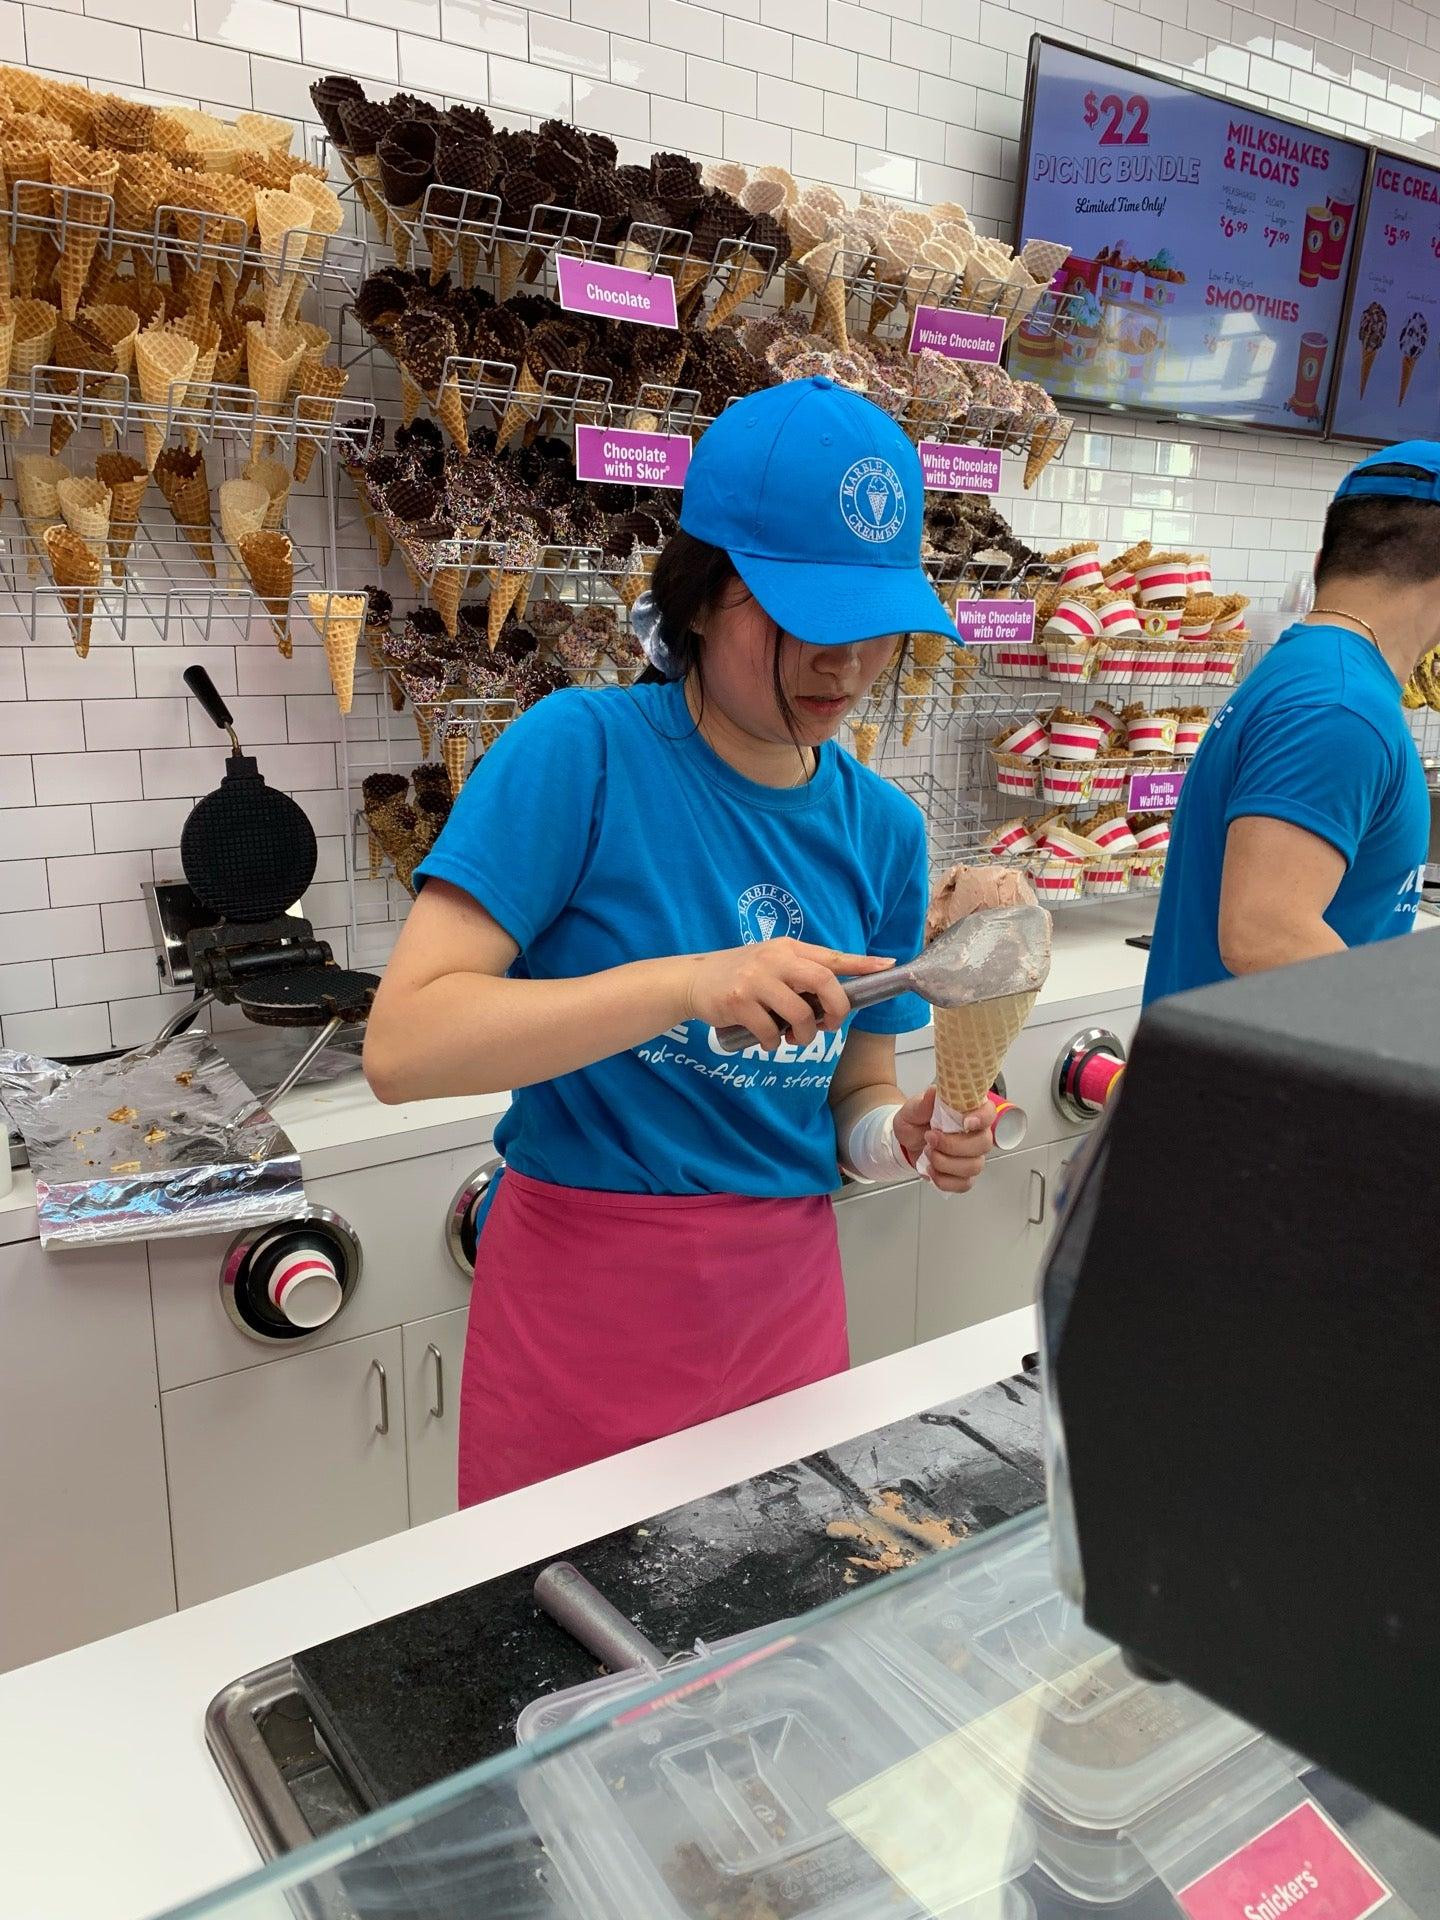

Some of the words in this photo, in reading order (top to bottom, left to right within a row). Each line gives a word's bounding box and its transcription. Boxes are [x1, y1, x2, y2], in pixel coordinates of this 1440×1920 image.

[1083, 90, 1150, 146] $22
[1227, 120, 1330, 170] MILKSHAKES
[1033, 153, 1112, 184] PICNIC
[1116, 155, 1201, 184] BUNDLE
[1223, 147, 1236, 169] &
[1240, 151, 1299, 187] FLOATS
[1376, 167, 1401, 192] ICE
[1403, 176, 1440, 206] CREA
[1075, 197, 1116, 214] Limited
[1117, 196, 1140, 213] Time
[1141, 196, 1167, 217] Only!
[1220, 215, 1248, 238] $6.99
[1263, 226, 1290, 247] $7.99
[1384, 224, 1410, 246] $5.99
[586, 283, 651, 310] Chocolate
[1205, 285, 1300, 323] SMOOTHIES
[919, 328, 948, 346] White
[949, 333, 996, 352] Chocolate
[603, 441, 667, 463] Chocolate
[604, 460, 633, 478] with
[922, 453, 951, 470] White
[952, 456, 998, 474] Chocolate
[842, 460, 883, 498] MARBLE
[926, 470, 947, 485] with
[949, 471, 993, 489] Sprinkles
[848, 513, 901, 540] CREAMERY
[960, 610, 987, 624] White
[988, 610, 1032, 625] Chocolate
[973, 624, 993, 639] with
[1150, 782, 1174, 795] Vanilla
[1139, 794, 1164, 807] Waffle
[779, 893, 801, 925] SLAB
[760, 1071, 777, 1087] in
[782, 1069, 832, 1089] stores
